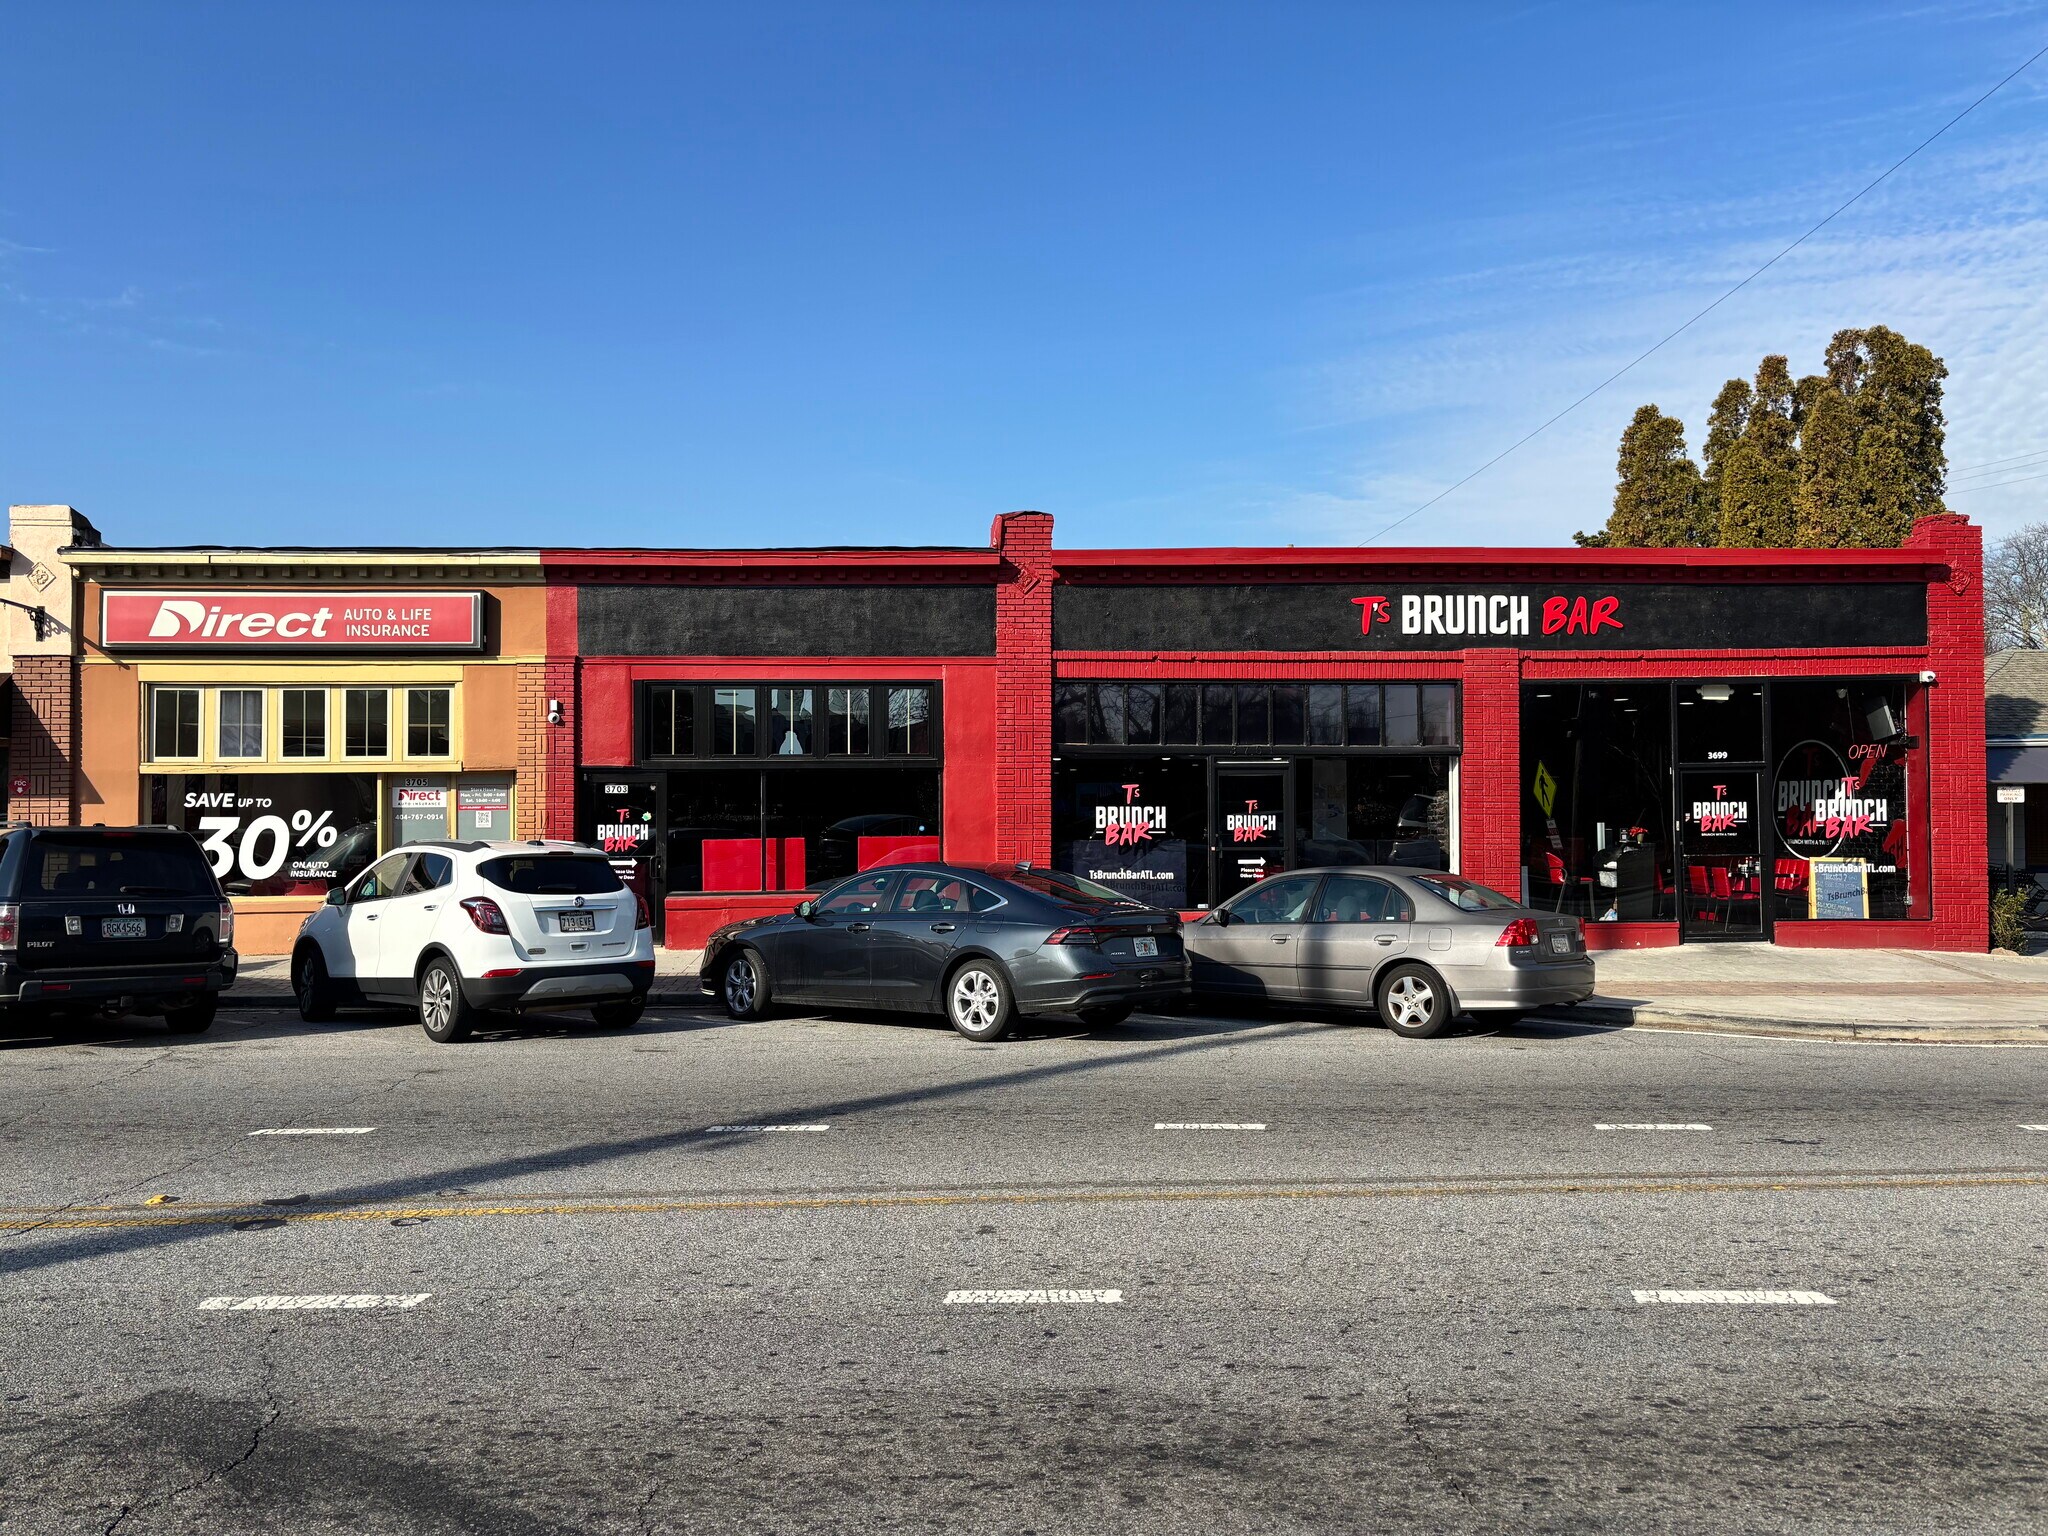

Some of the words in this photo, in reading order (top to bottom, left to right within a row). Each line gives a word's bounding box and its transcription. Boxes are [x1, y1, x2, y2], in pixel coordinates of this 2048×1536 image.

[148, 600, 333, 638] Direct
[344, 608, 382, 620] AUTO
[387, 608, 397, 620] &
[402, 608, 432, 620] LIFE
[1351, 596, 1391, 635] T's
[1401, 594, 1530, 635] BRUNCH
[1542, 596, 1624, 635] BAR
[346, 624, 430, 636] INSURANCE
[1707, 751, 1728, 759] 3699
[1848, 744, 1888, 760] OPEN
[406, 778, 428, 786] 3705
[605, 785, 628, 793] 3703
[1841, 776, 1860, 797] Ts
[184, 792, 235, 808] SAVE
[238, 799, 254, 807] UP
[256, 798, 272, 807] TO
[398, 788, 441, 801] Direct
[1122, 784, 1140, 804] Ts
[1713, 785, 1727, 800] Ts
[1245, 800, 1258, 814] Ts
[1693, 801, 1747, 819] BRUNCH
[1815, 798, 1887, 821] BRUNCH
[616, 809, 630, 823] Ts
[1095, 805, 1167, 829] BRUNCH
[1226, 814, 1276, 831] BRUNCH
[1701, 813, 1737, 832] BAR
[597, 824, 649, 840] BRUNCH
[1105, 821, 1152, 846] BAR
[1233, 826, 1267, 842] BAR
[1825, 814, 1873, 839] BAR
[198, 809, 338, 881] 30%
[604, 835, 639, 852] BAR
[290, 870, 337, 878] INSURANCE
[1089, 868, 1174, 880] TsBrunchBarATL.com
[106, 923, 142, 933] RGK4566
[561, 917, 576, 926] 713
